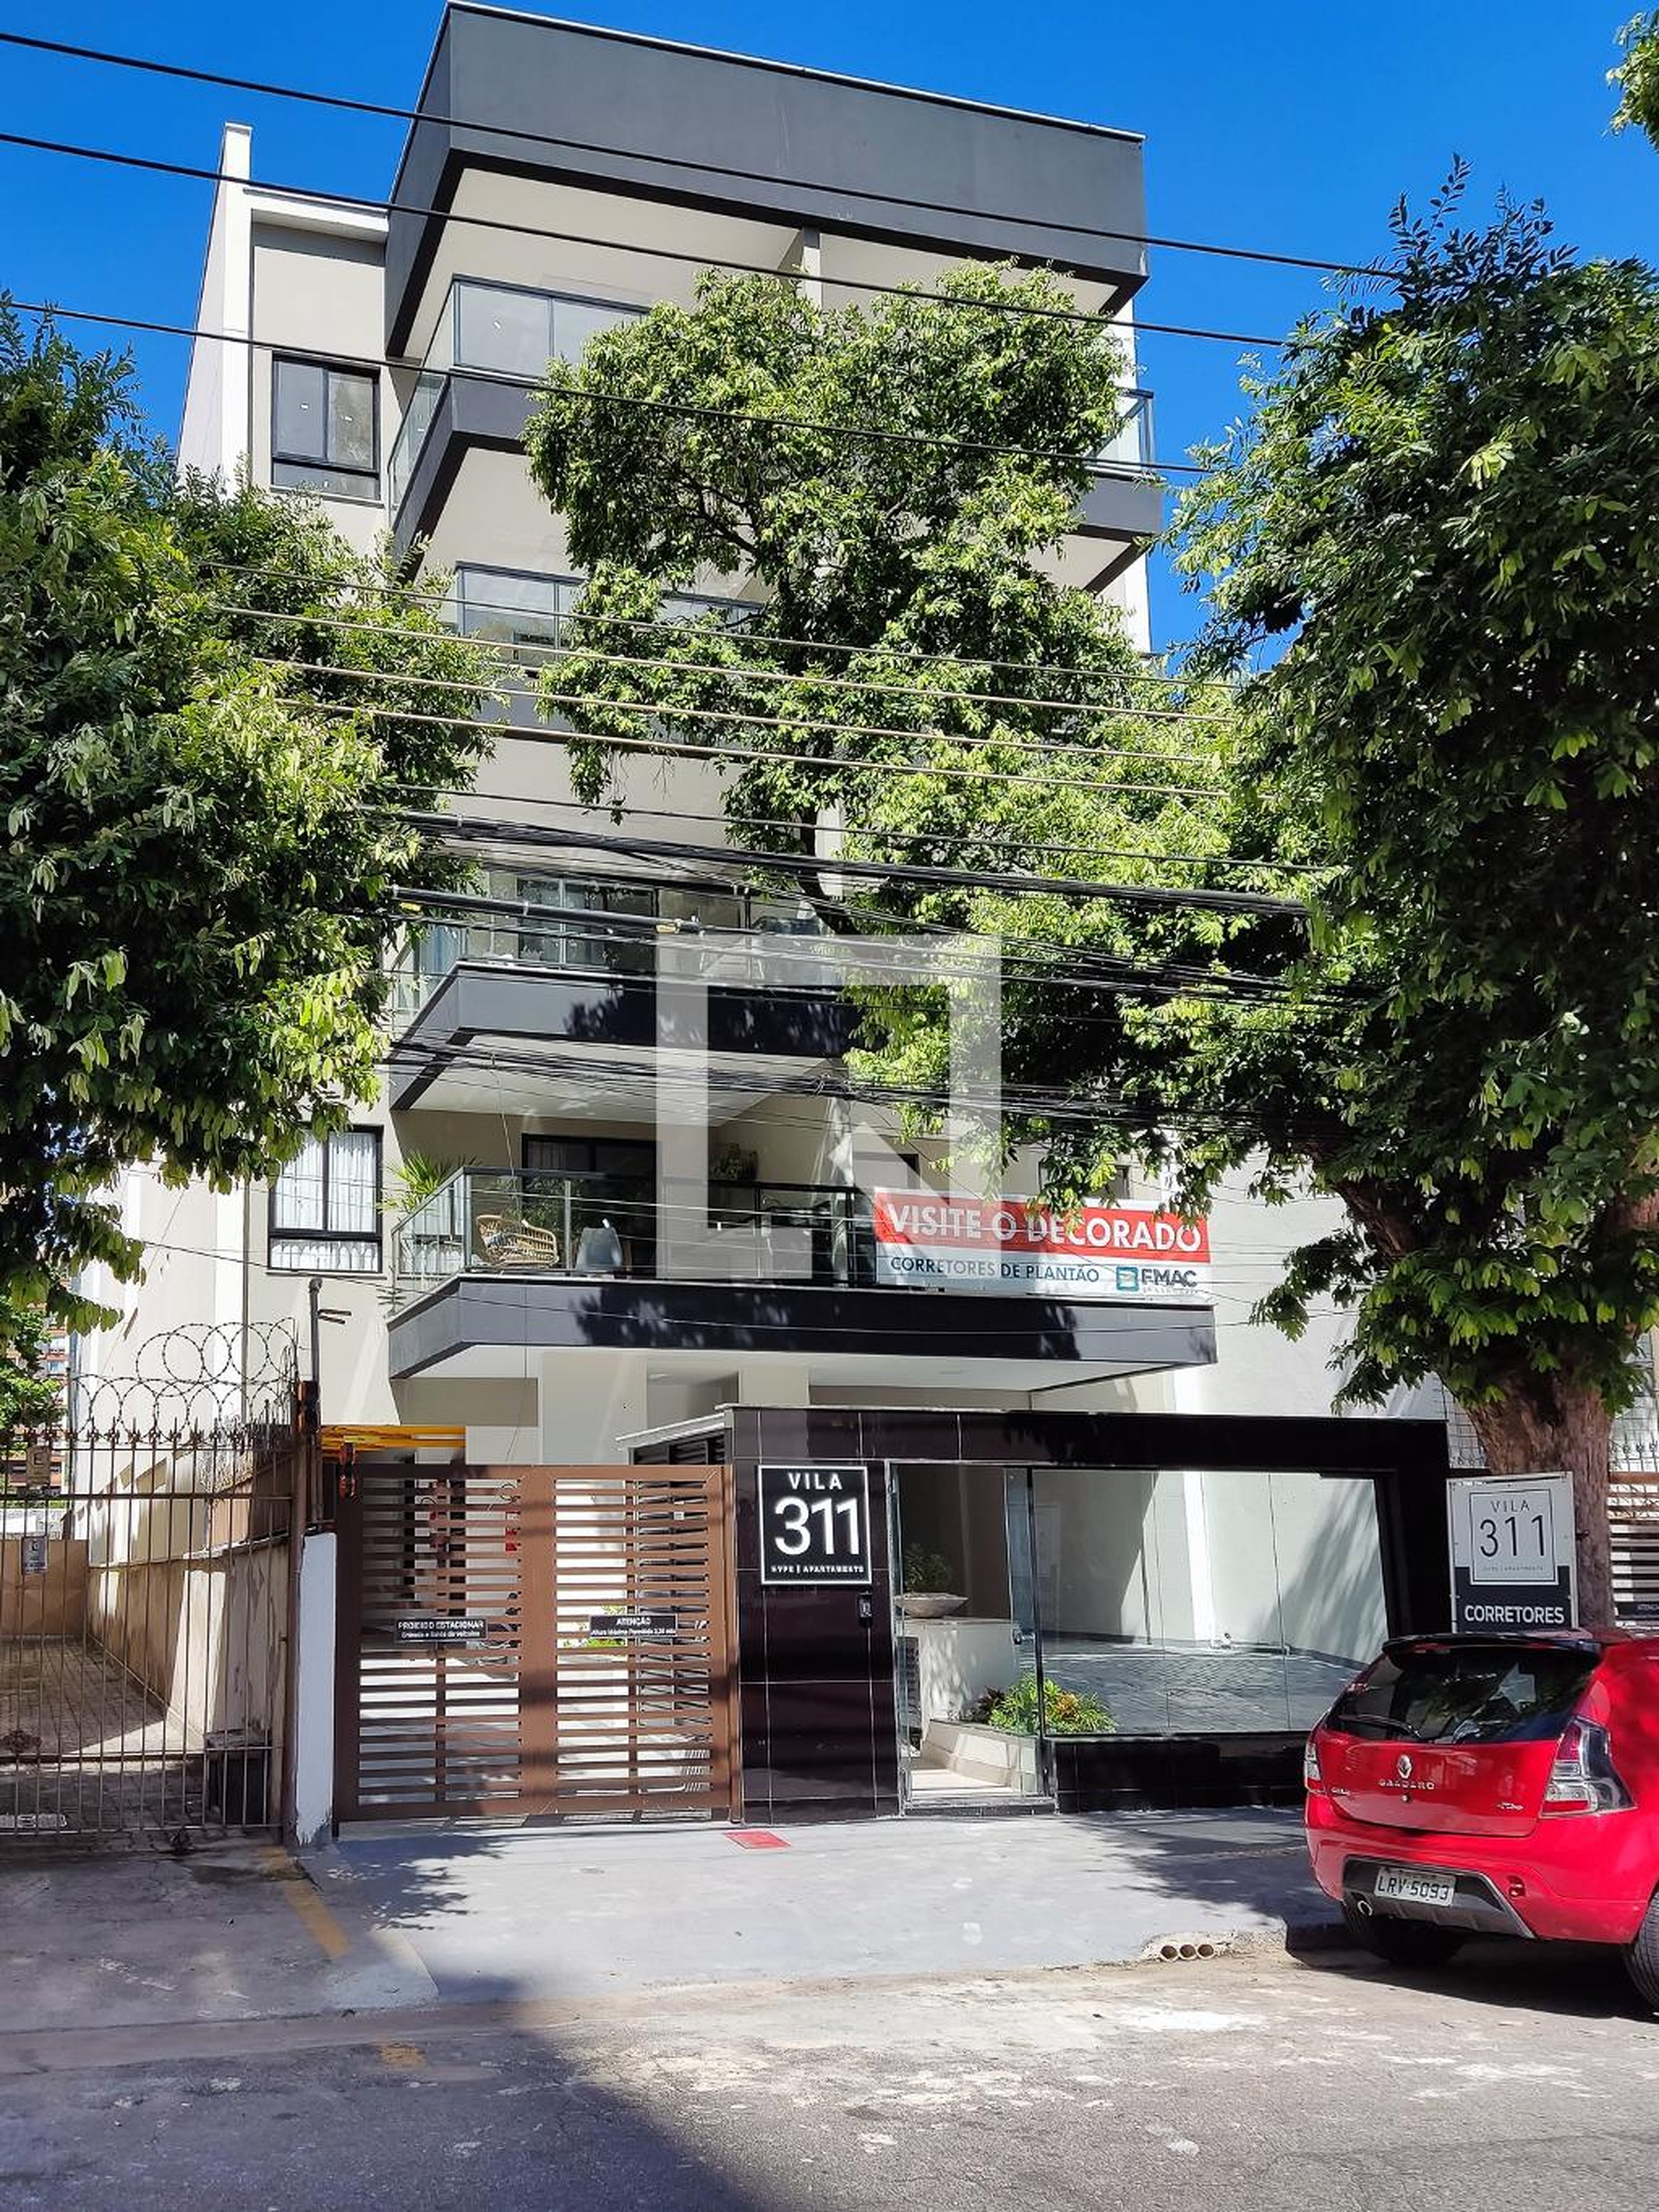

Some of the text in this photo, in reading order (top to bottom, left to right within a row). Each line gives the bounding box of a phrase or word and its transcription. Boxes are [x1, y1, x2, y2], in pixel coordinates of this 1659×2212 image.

[886, 1203, 1201, 1252] VISITE O DECORADO
[890, 1257, 1099, 1283] CORRETORES DE PLANTÃO
[1141, 1268, 1198, 1287] FMAC
[787, 1472, 842, 1490] VILA
[1491, 1500, 1530, 1513] VILA
[774, 1496, 860, 1556] 311
[1480, 1515, 1545, 1557] 311
[616, 1617, 652, 1626] ATENÇÃO
[1464, 1605, 1565, 1623] CORRETORES
[435, 1620, 484, 1629] ESTACIONAR
